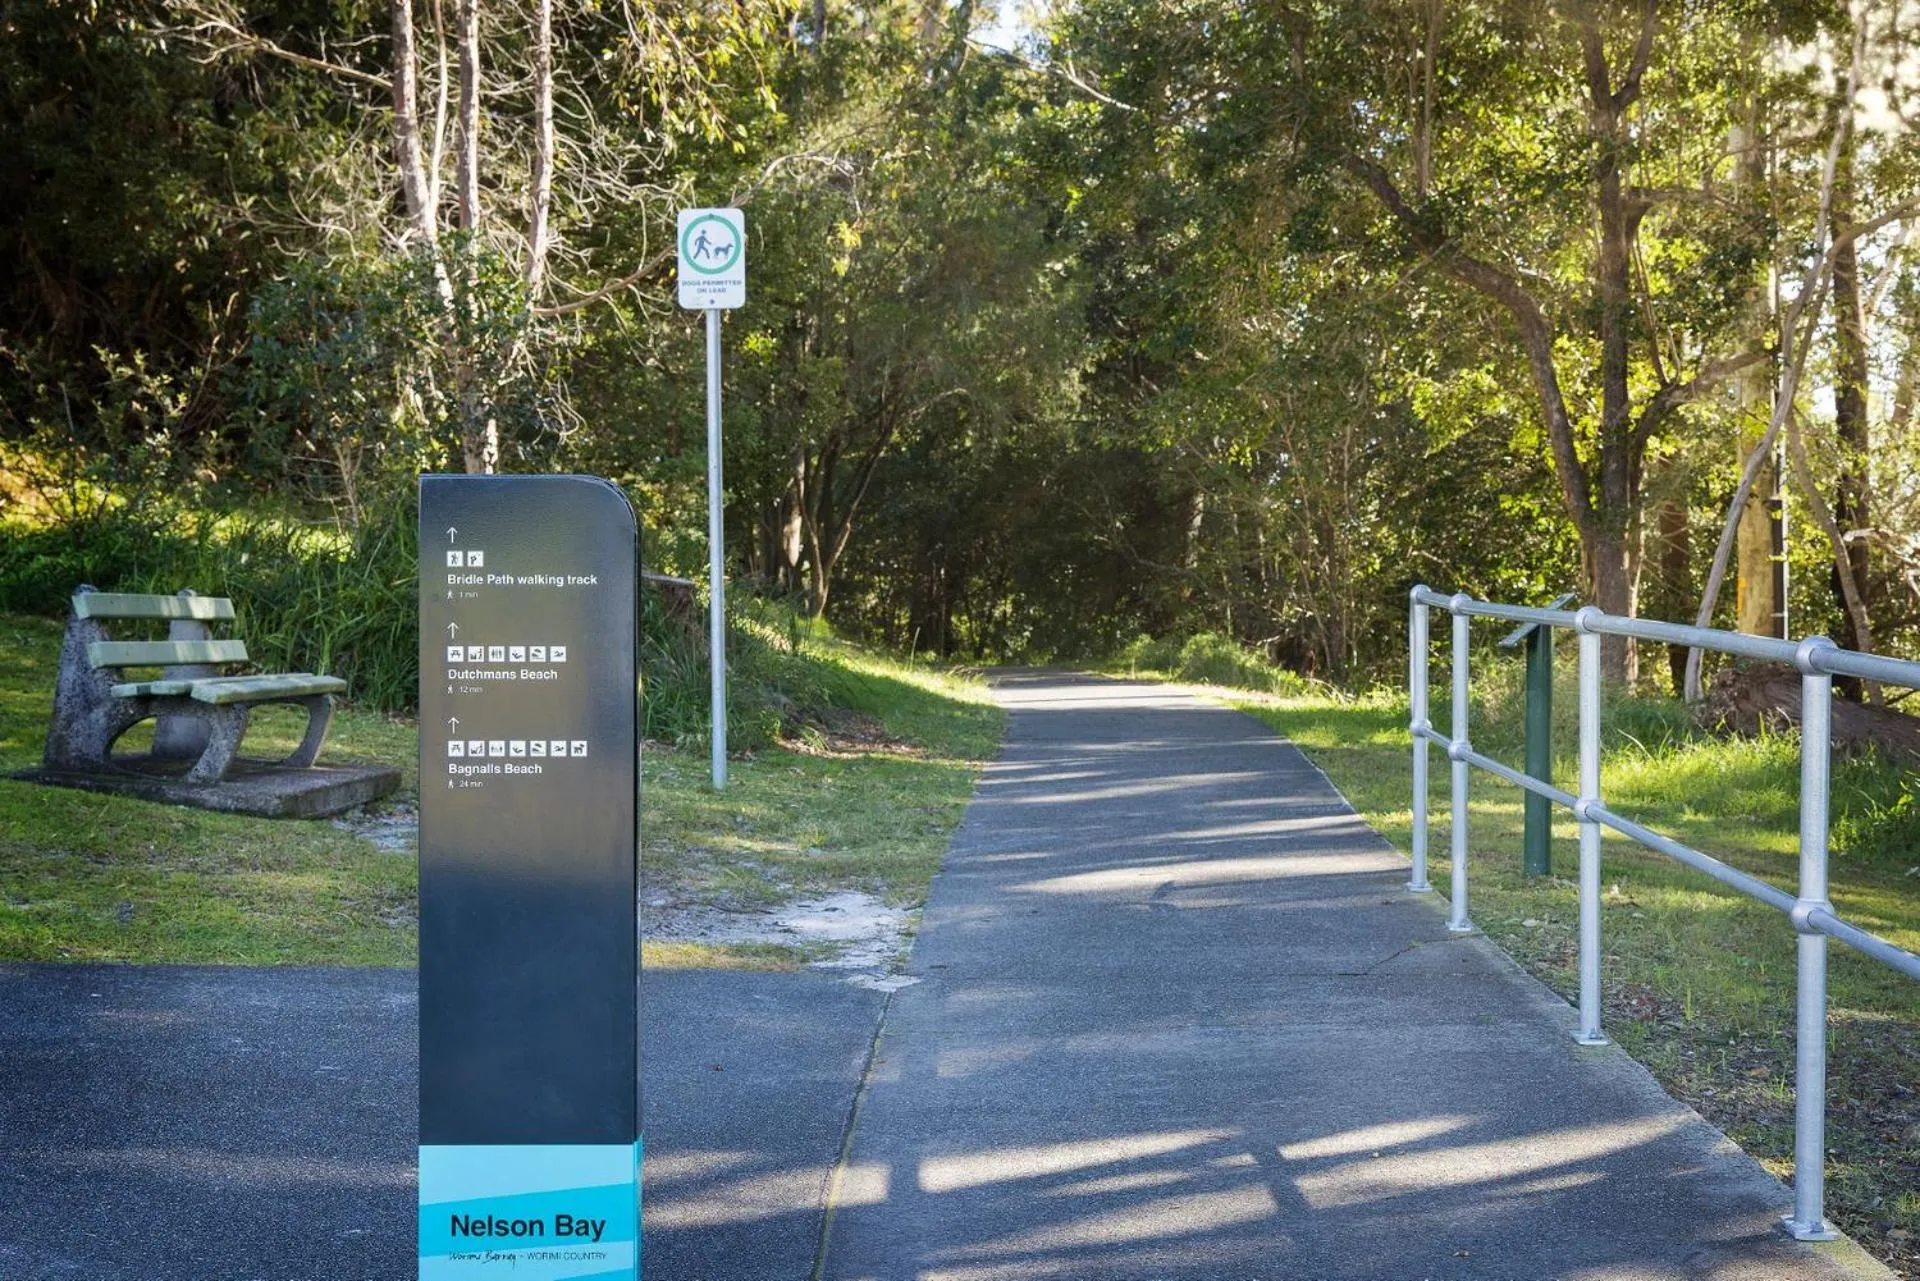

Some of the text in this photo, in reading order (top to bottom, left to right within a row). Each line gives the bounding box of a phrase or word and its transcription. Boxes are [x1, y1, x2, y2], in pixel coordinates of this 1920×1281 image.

[447, 574, 598, 587] Bridle Path walking track
[448, 668, 558, 680] Dutchmans Beach
[448, 763, 543, 777] Bagnalls Beach
[451, 1213, 607, 1243] Nelson Bay
[527, 1252, 562, 1261] WORIMI
[563, 1252, 607, 1261] COUNTRY
